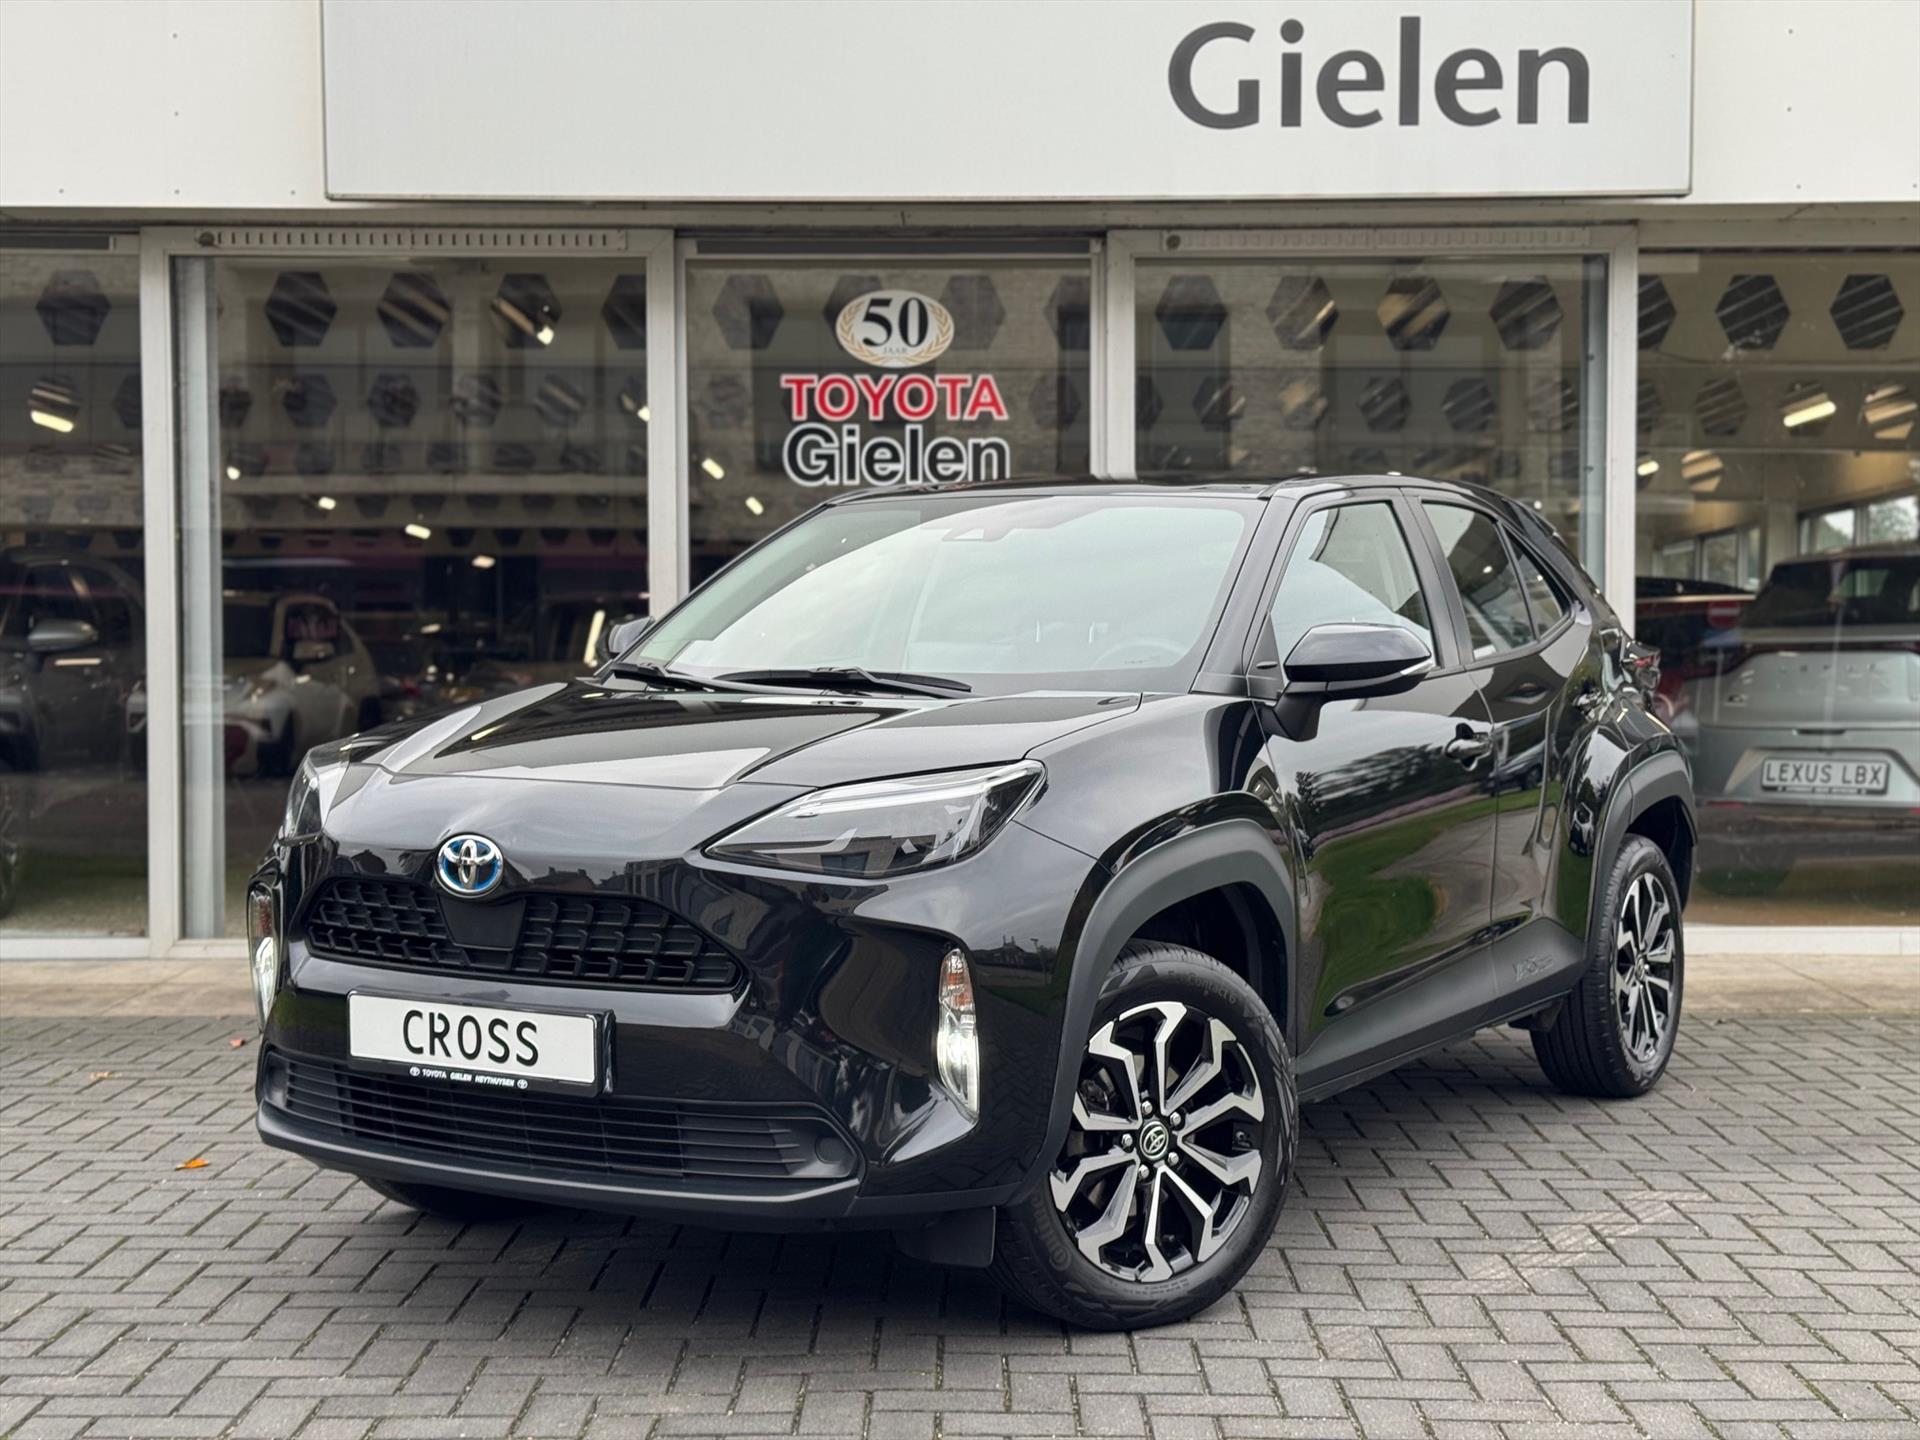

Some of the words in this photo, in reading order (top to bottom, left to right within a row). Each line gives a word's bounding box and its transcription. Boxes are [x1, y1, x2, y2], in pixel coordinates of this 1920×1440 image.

[1167, 15, 1590, 130] Gielen
[861, 296, 929, 348] 50
[781, 373, 1009, 421] TOYOTA
[782, 422, 1010, 487] Gielen
[1766, 763, 1832, 784] LEXUS
[1841, 764, 1883, 786] LBX
[402, 1008, 540, 1067] CROSS
[422, 1068, 447, 1080] TOYOTA
[449, 1071, 473, 1083] GIELEN
